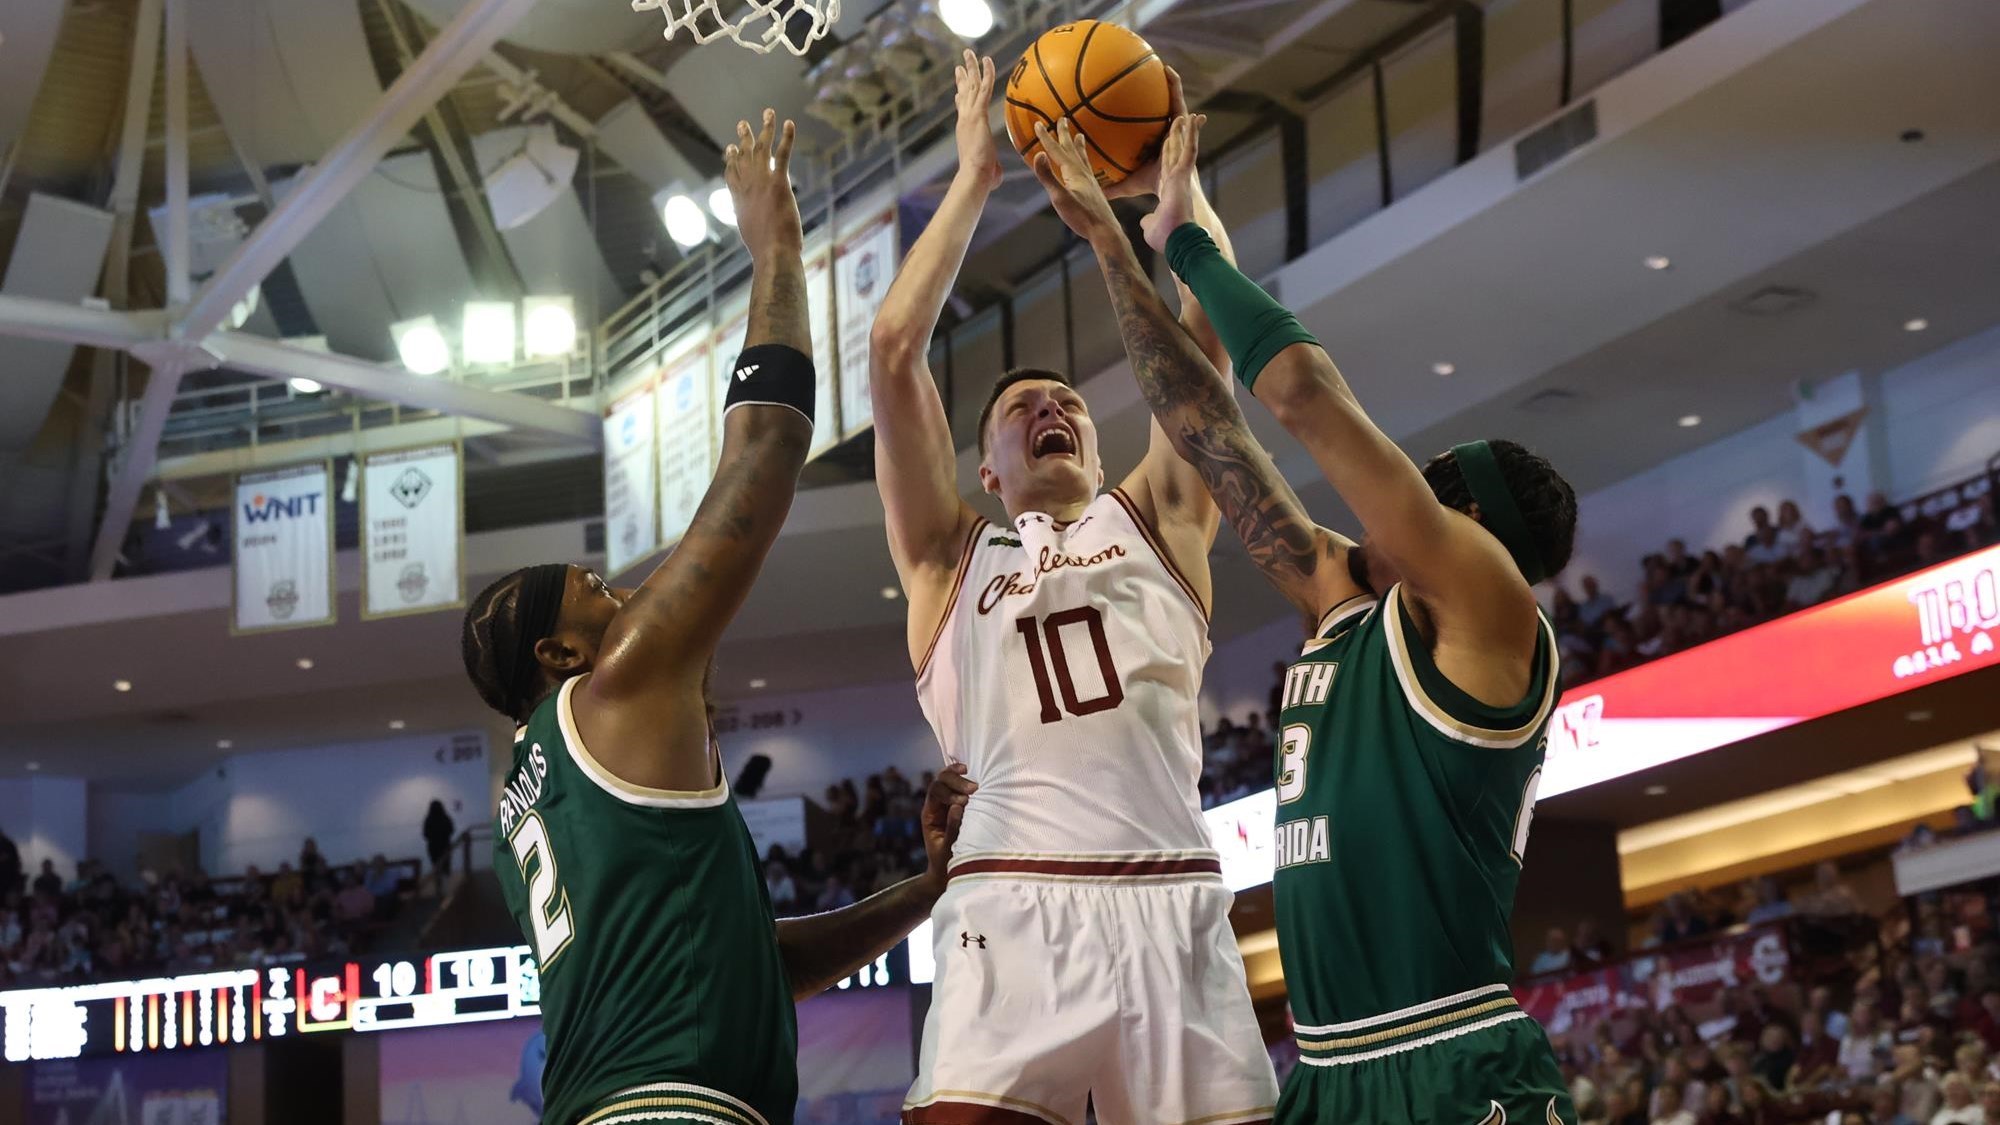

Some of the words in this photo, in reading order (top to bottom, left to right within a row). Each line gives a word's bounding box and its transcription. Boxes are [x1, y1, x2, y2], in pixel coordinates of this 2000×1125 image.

[244, 494, 321, 523] WNIT
[977, 544, 1126, 616] Chaleston
[1015, 605, 1124, 725] 10
[1281, 661, 1340, 711] UTH
[1276, 722, 1313, 806] 3
[1274, 815, 1331, 870] RIDA
[508, 808, 576, 974] 2
[373, 960, 416, 998] 10
[451, 957, 495, 989] 10
